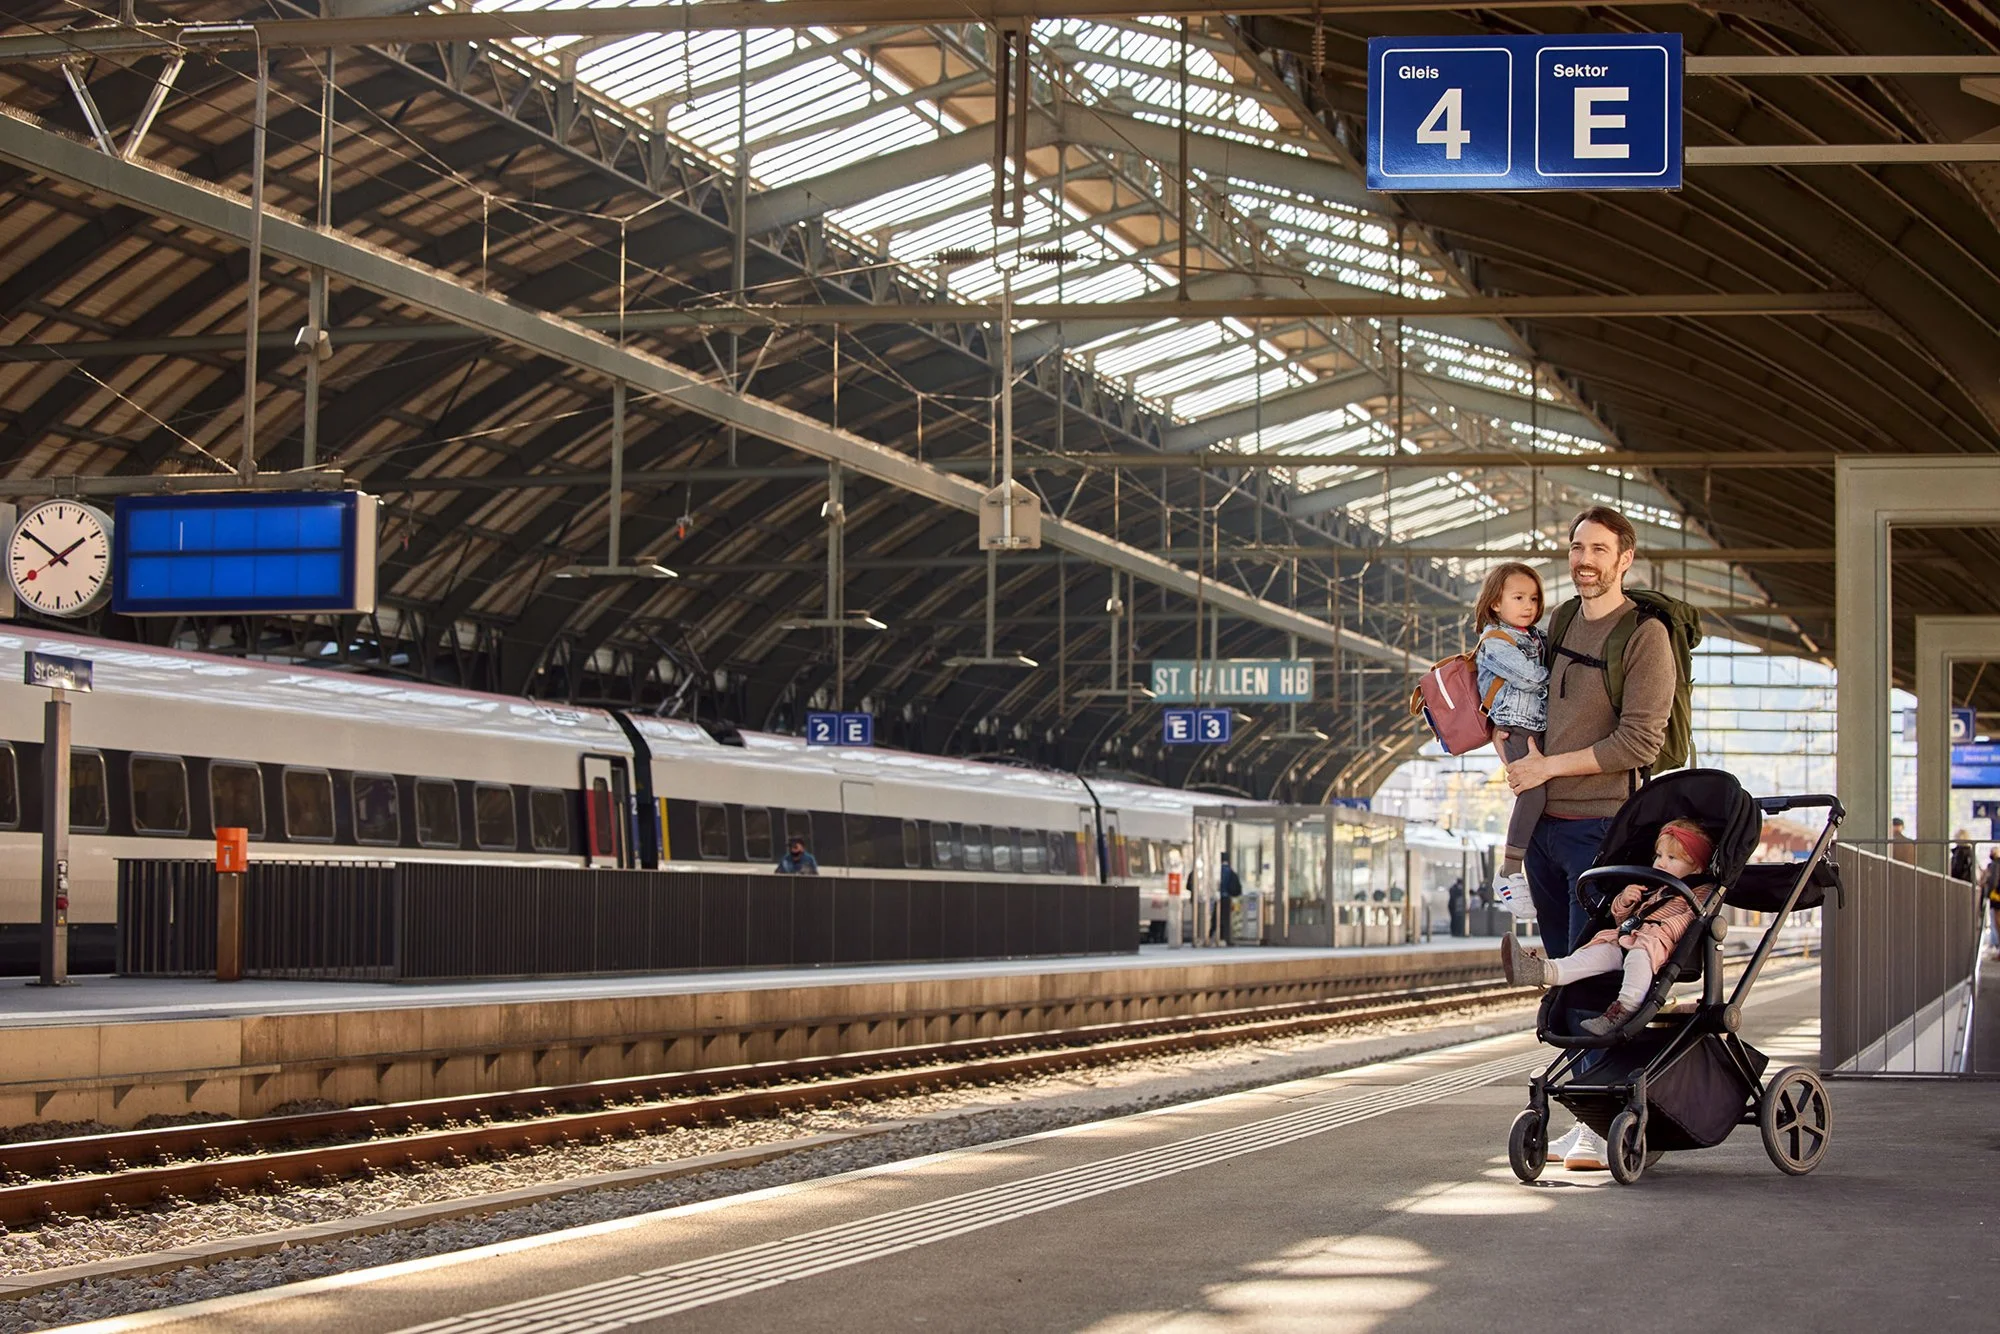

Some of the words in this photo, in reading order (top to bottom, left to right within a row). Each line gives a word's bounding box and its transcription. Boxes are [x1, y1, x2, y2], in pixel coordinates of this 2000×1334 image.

[1398, 65, 1440, 80] Gleis
[1553, 63, 1608, 78] Sektor
[1416, 88, 1471, 160] 4
[1573, 86, 1630, 159] E
[1155, 667, 1184, 695] ST.
[1280, 667, 1309, 695] HB
[816, 723, 830, 741] 2
[848, 723, 863, 741] E
[1172, 719, 1187, 739] E
[1206, 719, 1221, 739] 3
